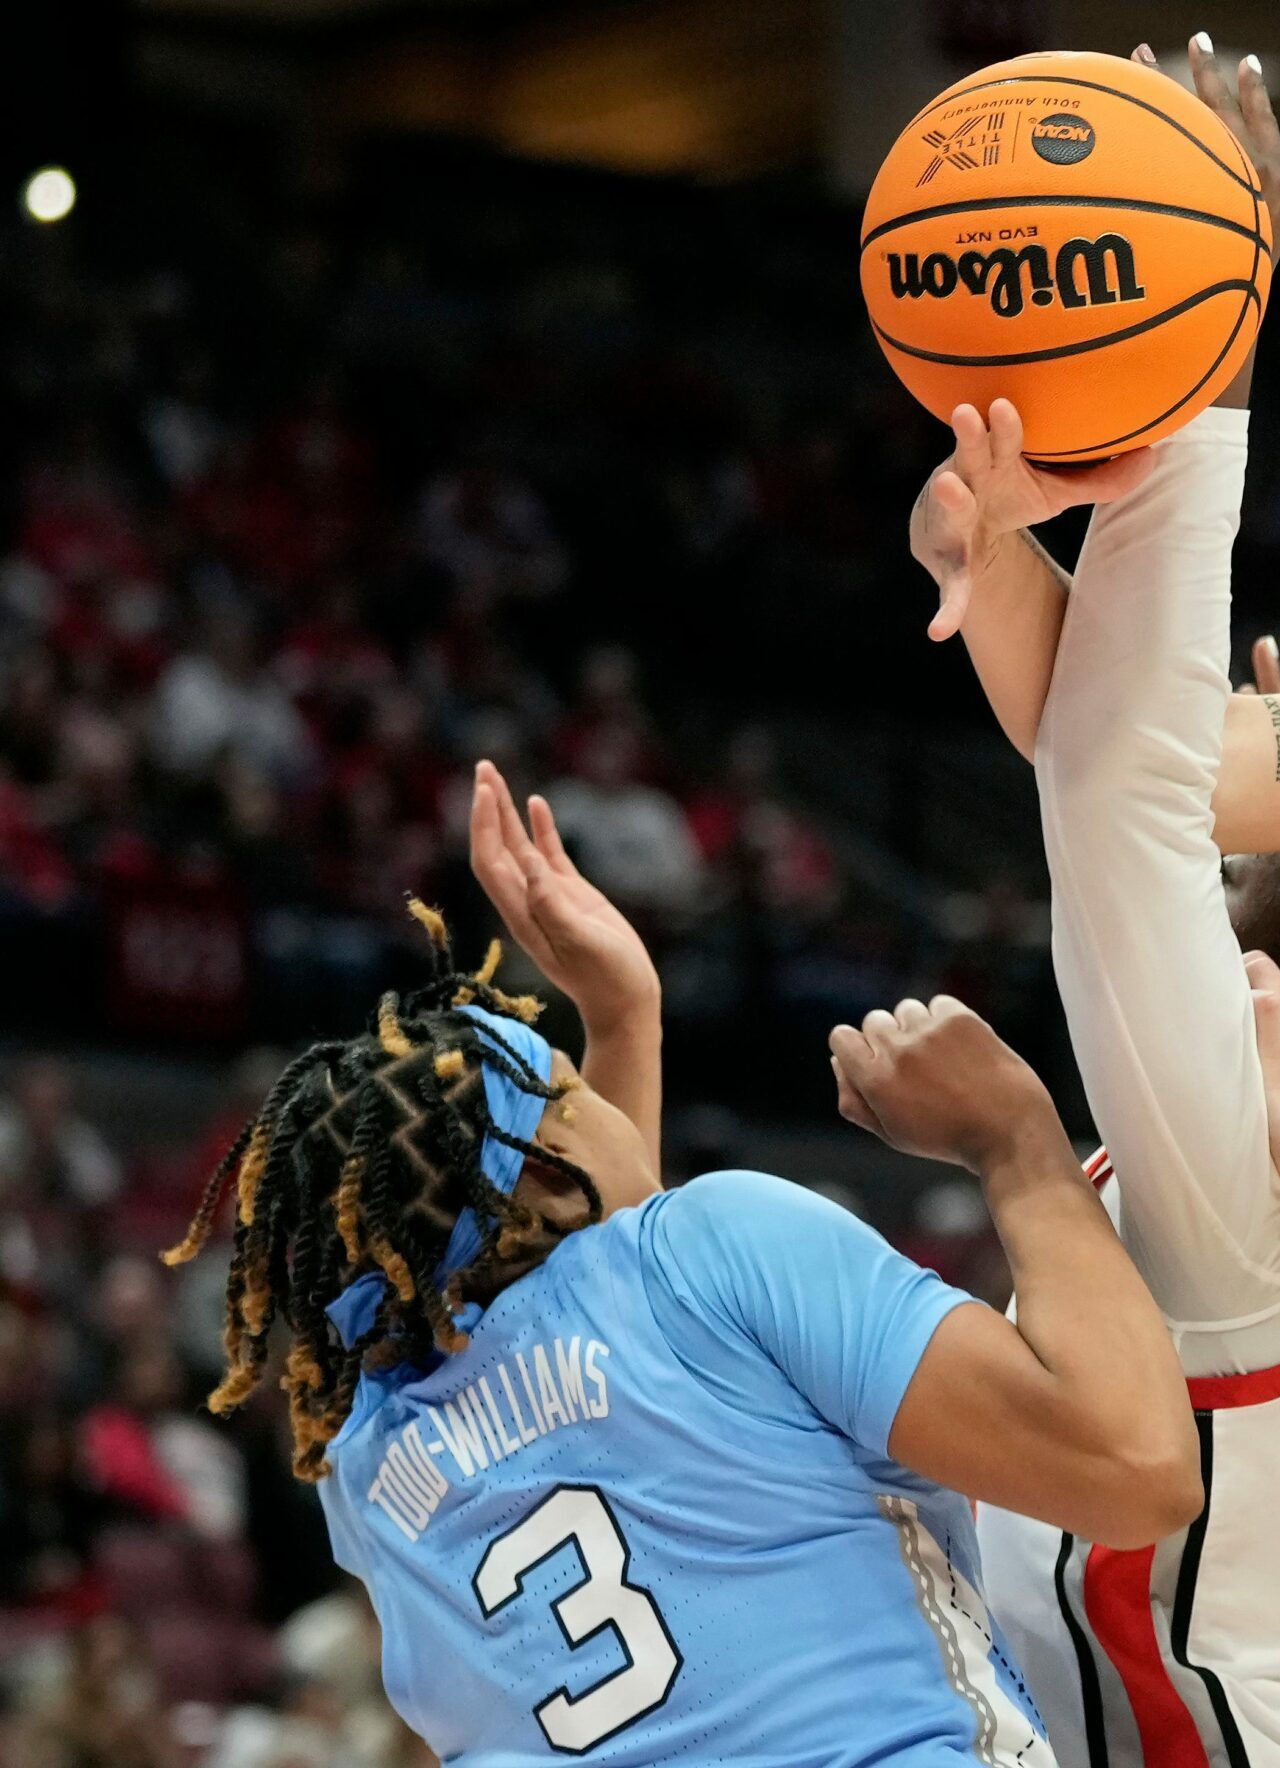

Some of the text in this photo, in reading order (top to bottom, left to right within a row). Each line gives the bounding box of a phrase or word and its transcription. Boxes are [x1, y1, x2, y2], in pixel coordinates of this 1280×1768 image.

[940, 97, 1080, 121] 50th Anniversary
[943, 132, 1000, 154] TITLE
[1032, 123, 1091, 142] NCAA
[954, 226, 1038, 244] EVO NXT
[885, 231, 1146, 319] Wilson
[366, 1335, 612, 1543] TODD-WILLIAMS
[471, 1484, 684, 1757] 3
